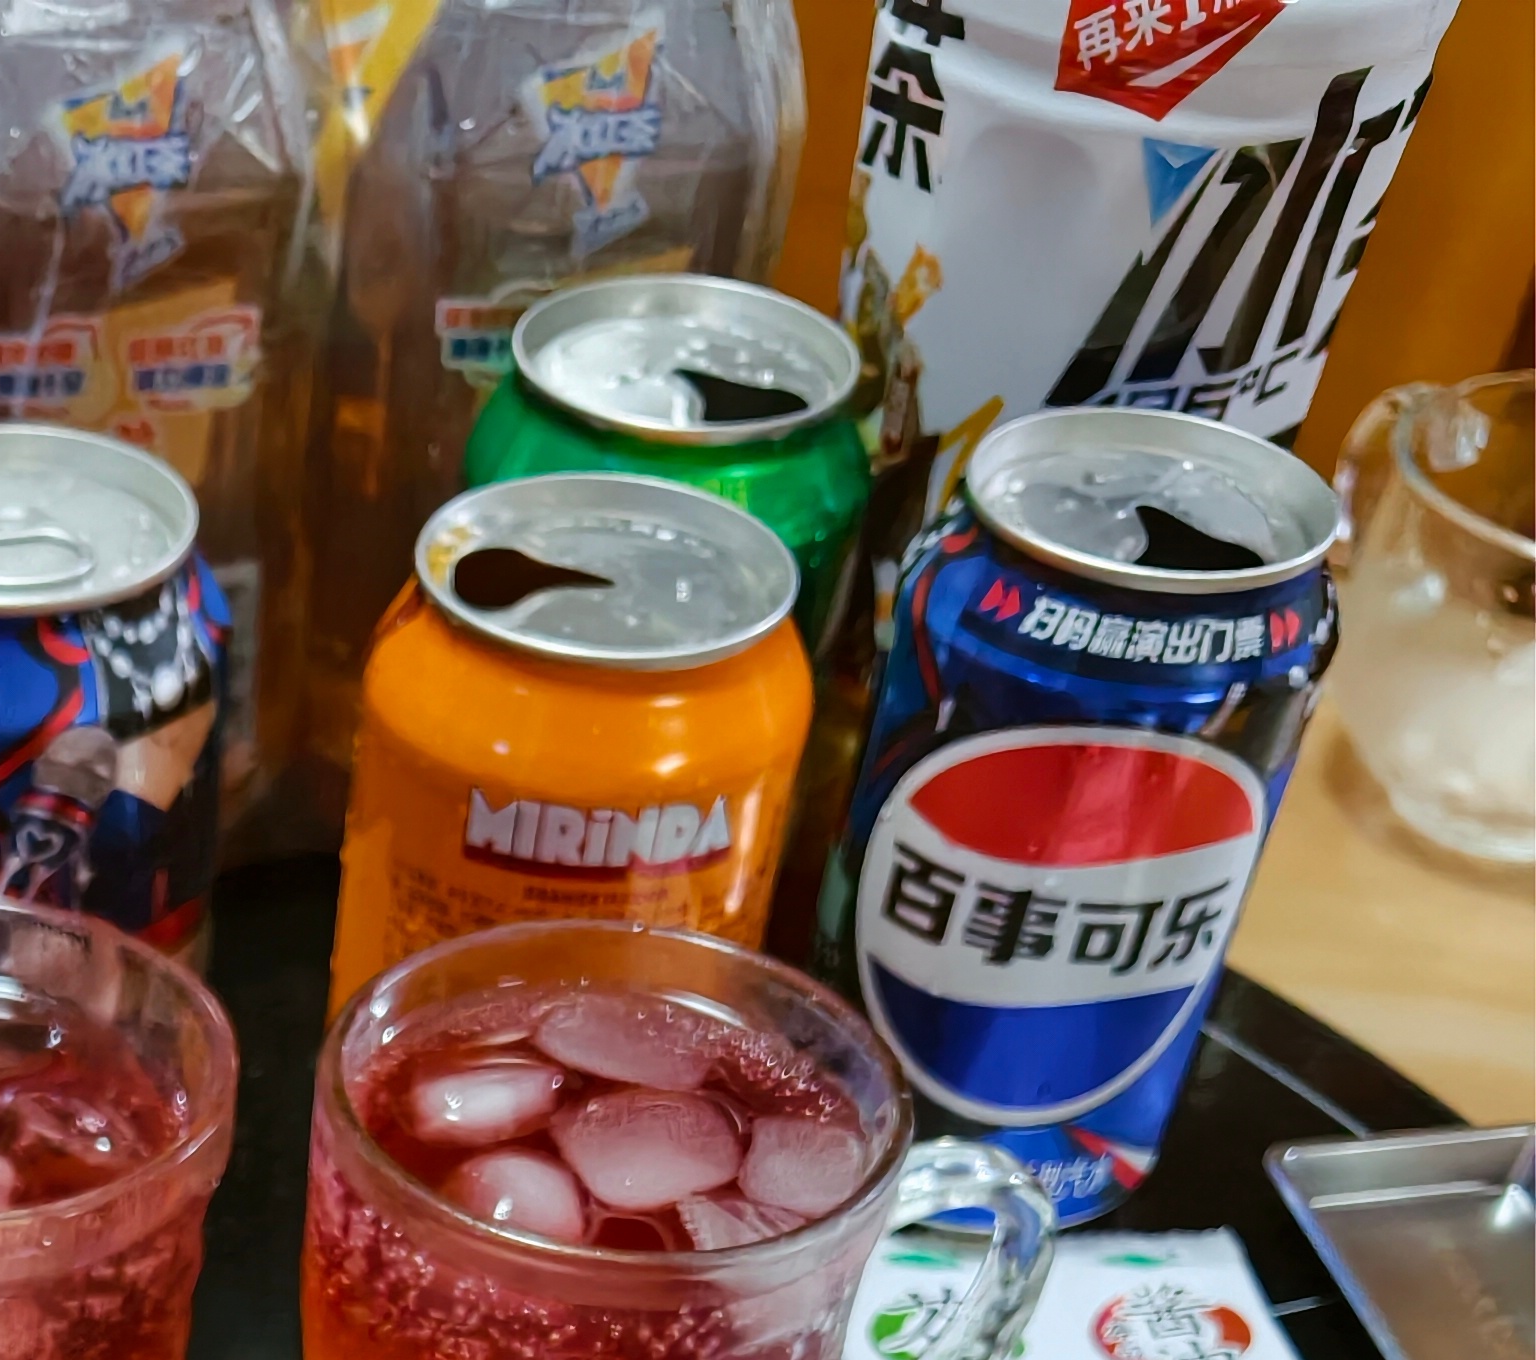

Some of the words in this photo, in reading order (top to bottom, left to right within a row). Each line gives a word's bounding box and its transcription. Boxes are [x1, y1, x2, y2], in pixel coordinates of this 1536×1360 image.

[1074, 0, 1244, 72] 再来1
[1024, 595, 1265, 664] 扫码赢演出门票
[879, 842, 1232, 976] 百事可乐
